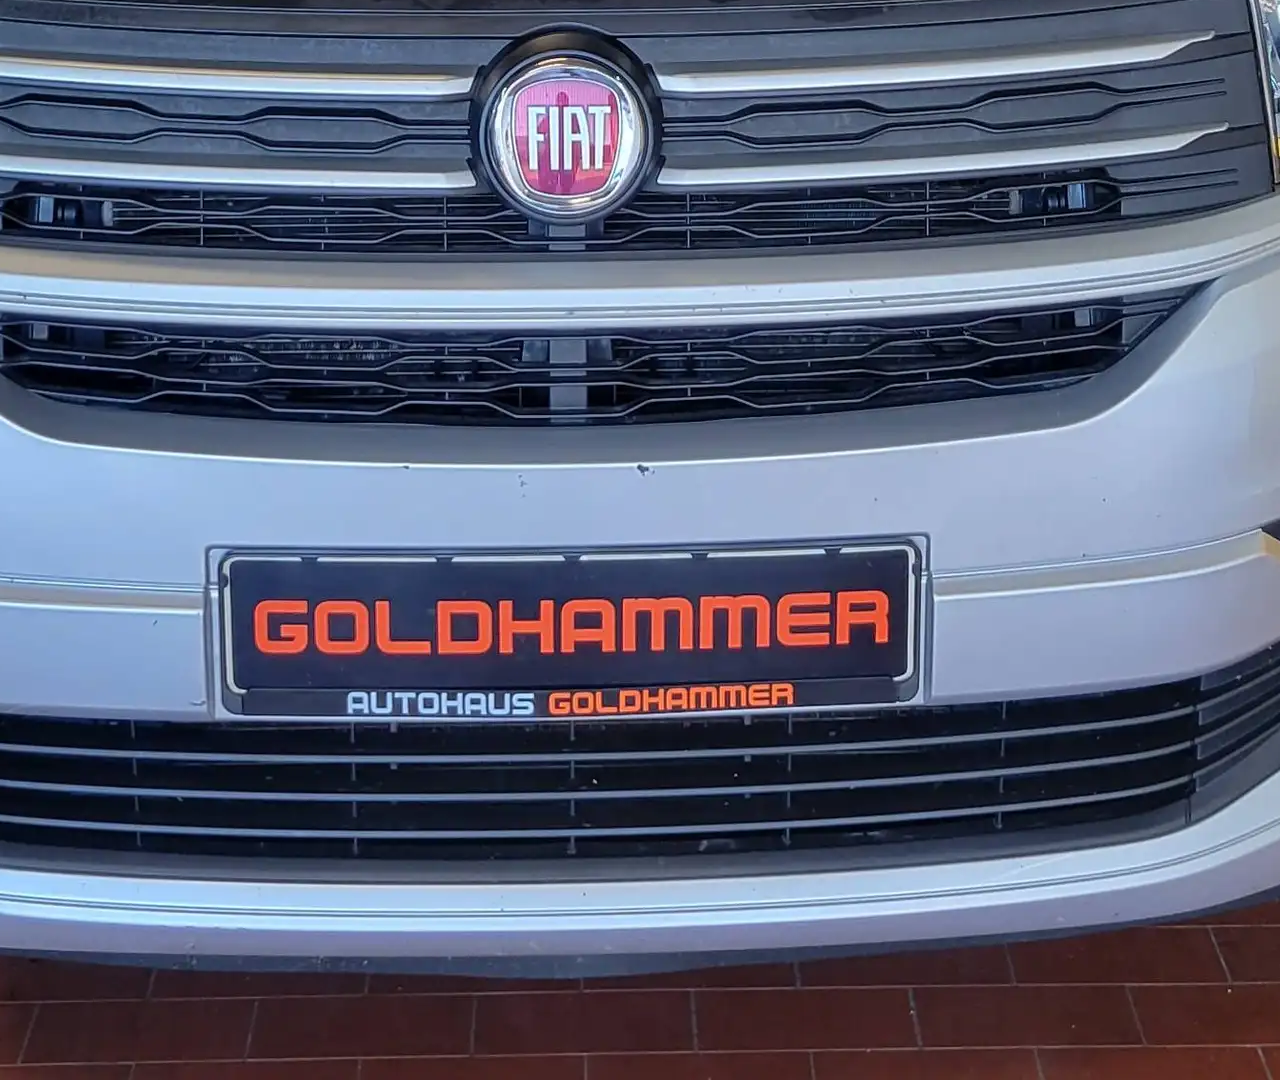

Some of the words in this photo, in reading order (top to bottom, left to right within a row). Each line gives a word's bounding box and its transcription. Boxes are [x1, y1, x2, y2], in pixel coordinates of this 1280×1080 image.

[528, 106, 611, 170] FIAT
[254, 590, 889, 654] GOLDHAMMER
[347, 691, 535, 716] AUTOHAUS
[549, 683, 794, 715] GOLDHAMMER
